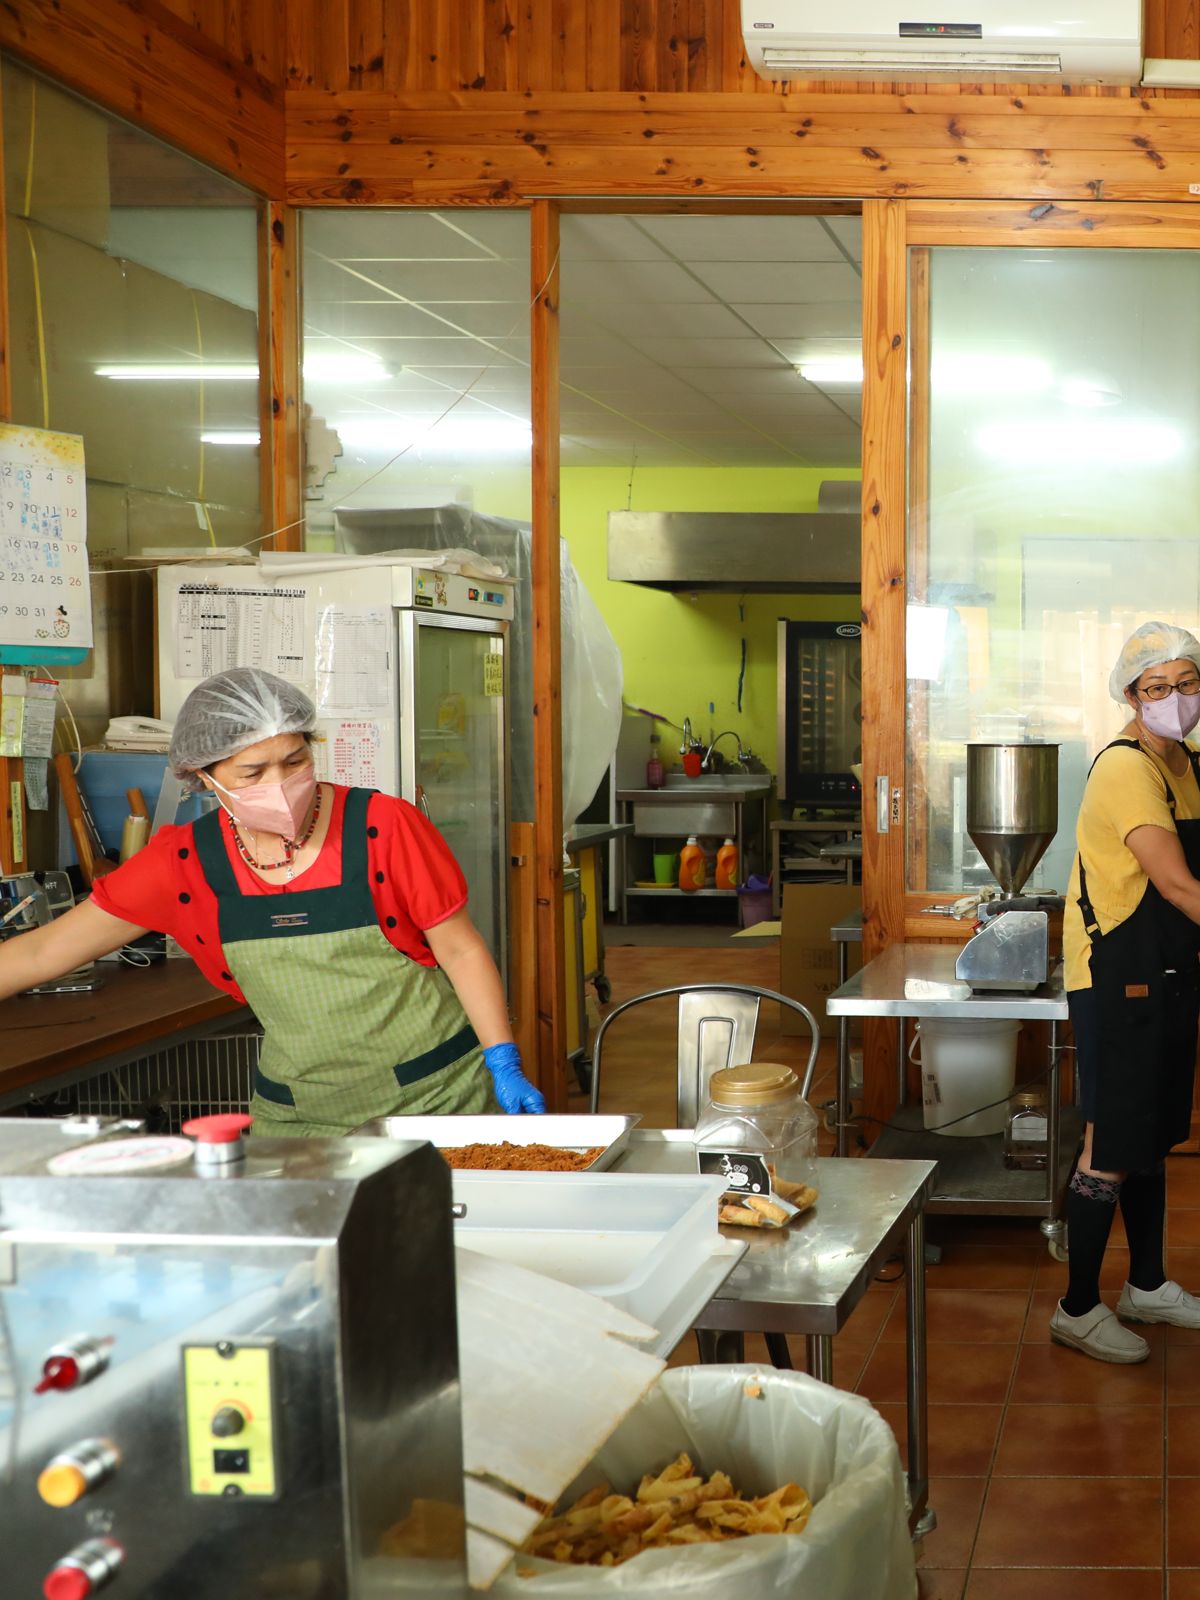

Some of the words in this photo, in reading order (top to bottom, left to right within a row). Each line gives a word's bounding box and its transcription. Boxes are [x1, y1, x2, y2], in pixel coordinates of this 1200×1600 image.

[4, 467, 12, 477] 2
[25, 470, 32, 479] 3
[46, 473, 53, 481] 4
[66, 475, 74, 484] 5
[7, 501, 14, 510] 9
[24, 504, 38, 514] 10
[45, 506, 58, 515] 11
[65, 508, 78, 518] 12
[8, 539, 21, 549] 16
[47, 543, 60, 552] 18
[66, 544, 78, 553] 19
[11, 572, 25, 582] 23
[31, 574, 45, 583] 24
[50, 576, 63, 585] 25
[69, 577, 82, 587] 26
[15, 606, 29, 616] 30
[34, 608, 46, 617] 31
